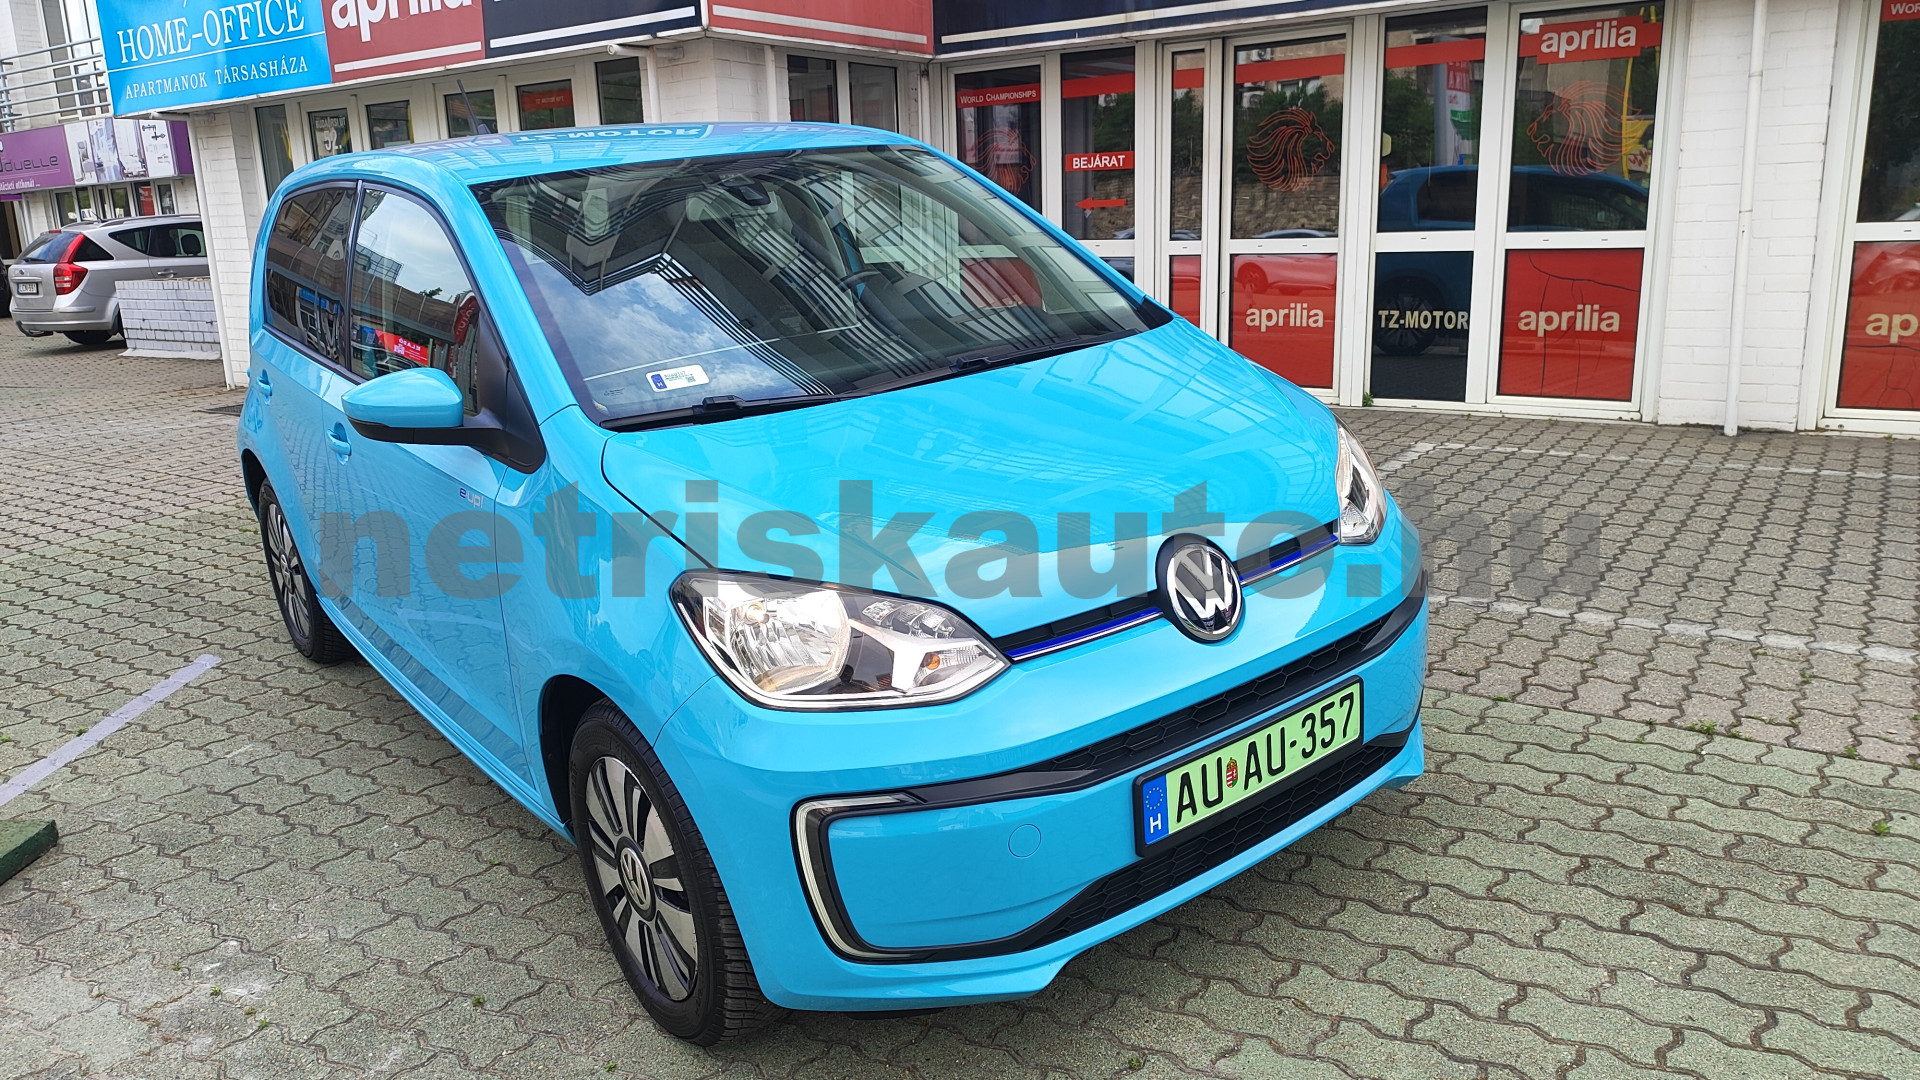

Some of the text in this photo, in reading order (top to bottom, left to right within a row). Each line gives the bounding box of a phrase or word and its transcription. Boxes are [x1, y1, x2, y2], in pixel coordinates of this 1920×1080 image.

[117, 0, 305, 63] HOME-OFFICE
[1540, 20, 1637, 59] aprilia
[125, 55, 308, 100] APARTMANOK TÁRSASHÁZA
[1072, 153, 1126, 169] BEJÁRAT
[1245, 303, 1324, 332] aprilia
[1378, 310, 1469, 330] TZ-MOTOR
[1517, 304, 1620, 337] aprilia
[1149, 812, 1162, 835] H
